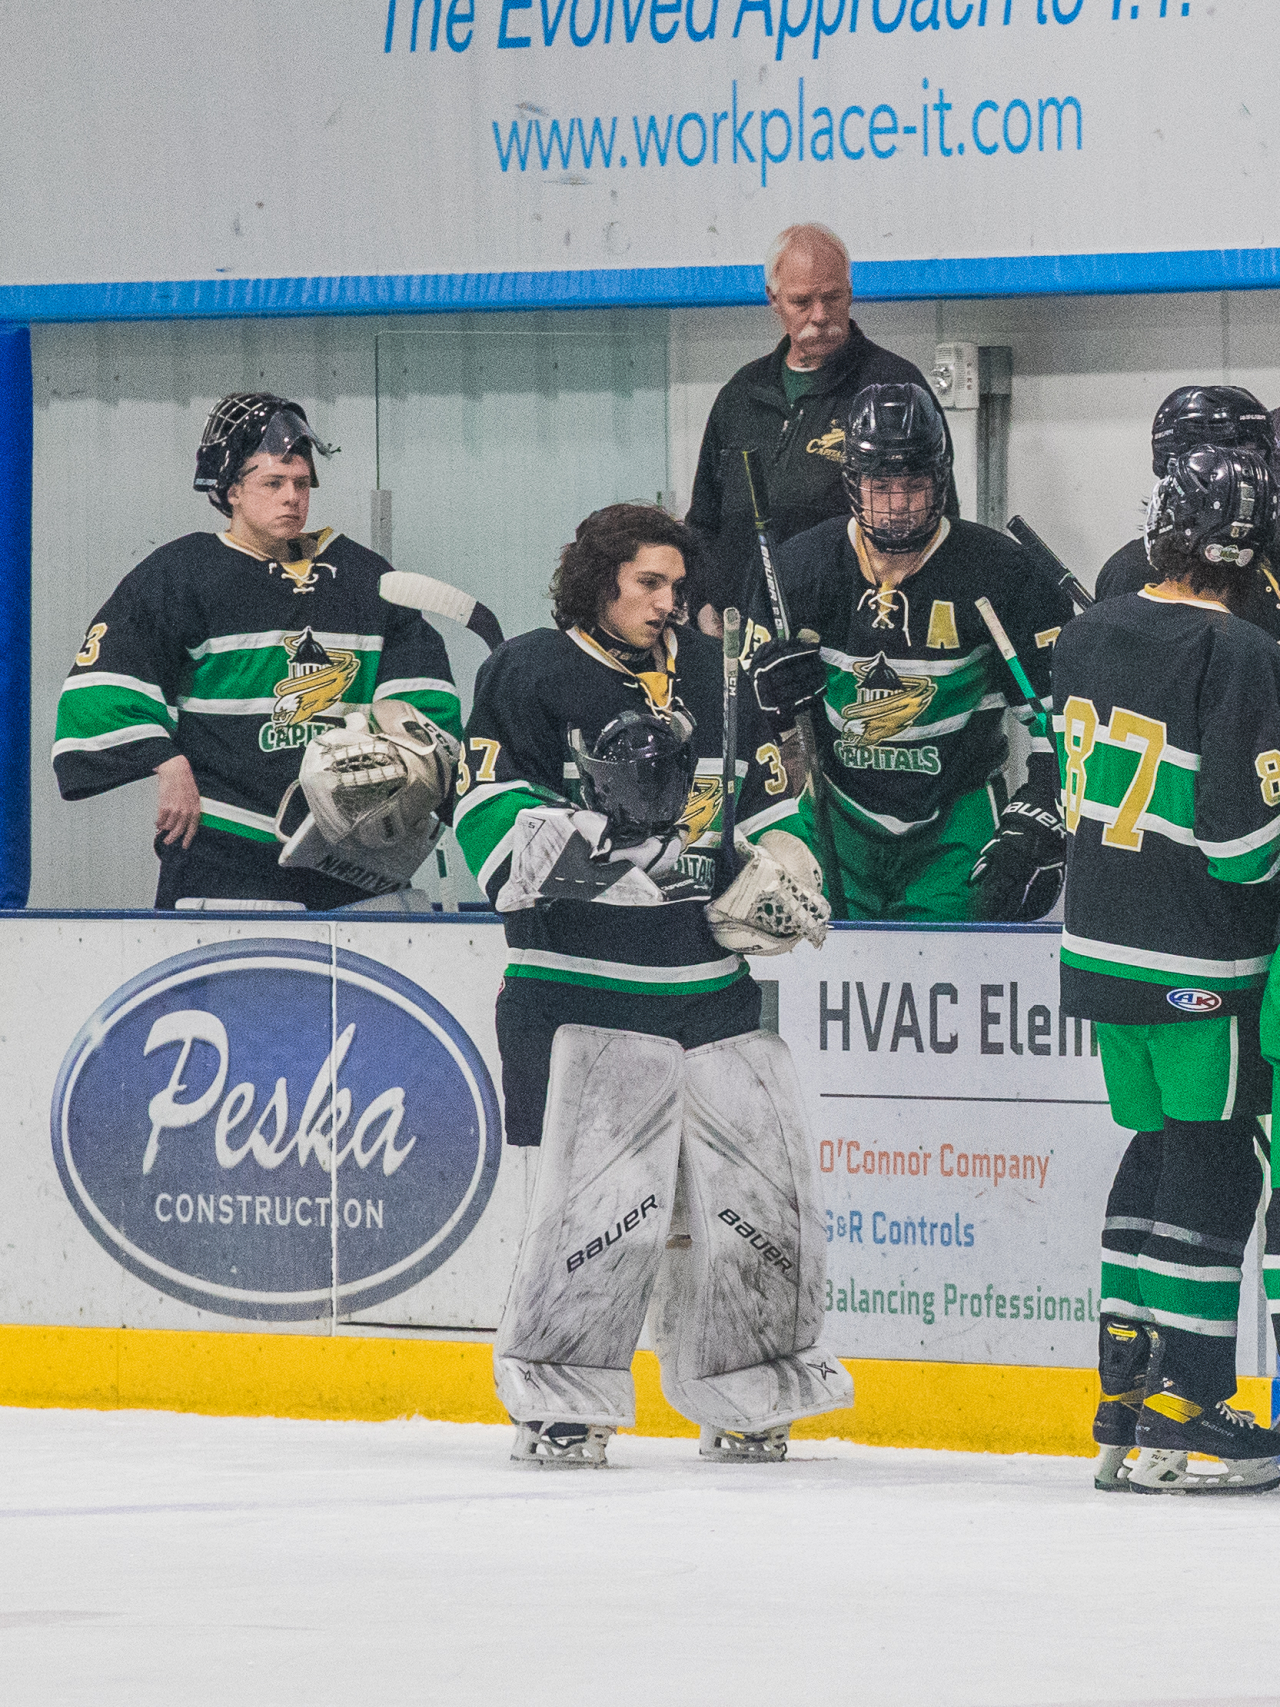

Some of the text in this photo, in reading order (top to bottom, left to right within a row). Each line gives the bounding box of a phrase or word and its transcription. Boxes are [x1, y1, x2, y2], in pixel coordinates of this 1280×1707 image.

[732, 0, 1010, 61] Approac
[493, 78, 1083, 188] www.workplace-it.com
[1062, 694, 1168, 853] 87
[819, 980, 959, 1055] HVAC
[141, 1009, 417, 1176] Peska
[819, 1138, 1050, 1189] O'Connor Company
[566, 1194, 659, 1274] BAUER
[717, 1208, 793, 1274] BAUER
[872, 1210, 975, 1248] Controls
